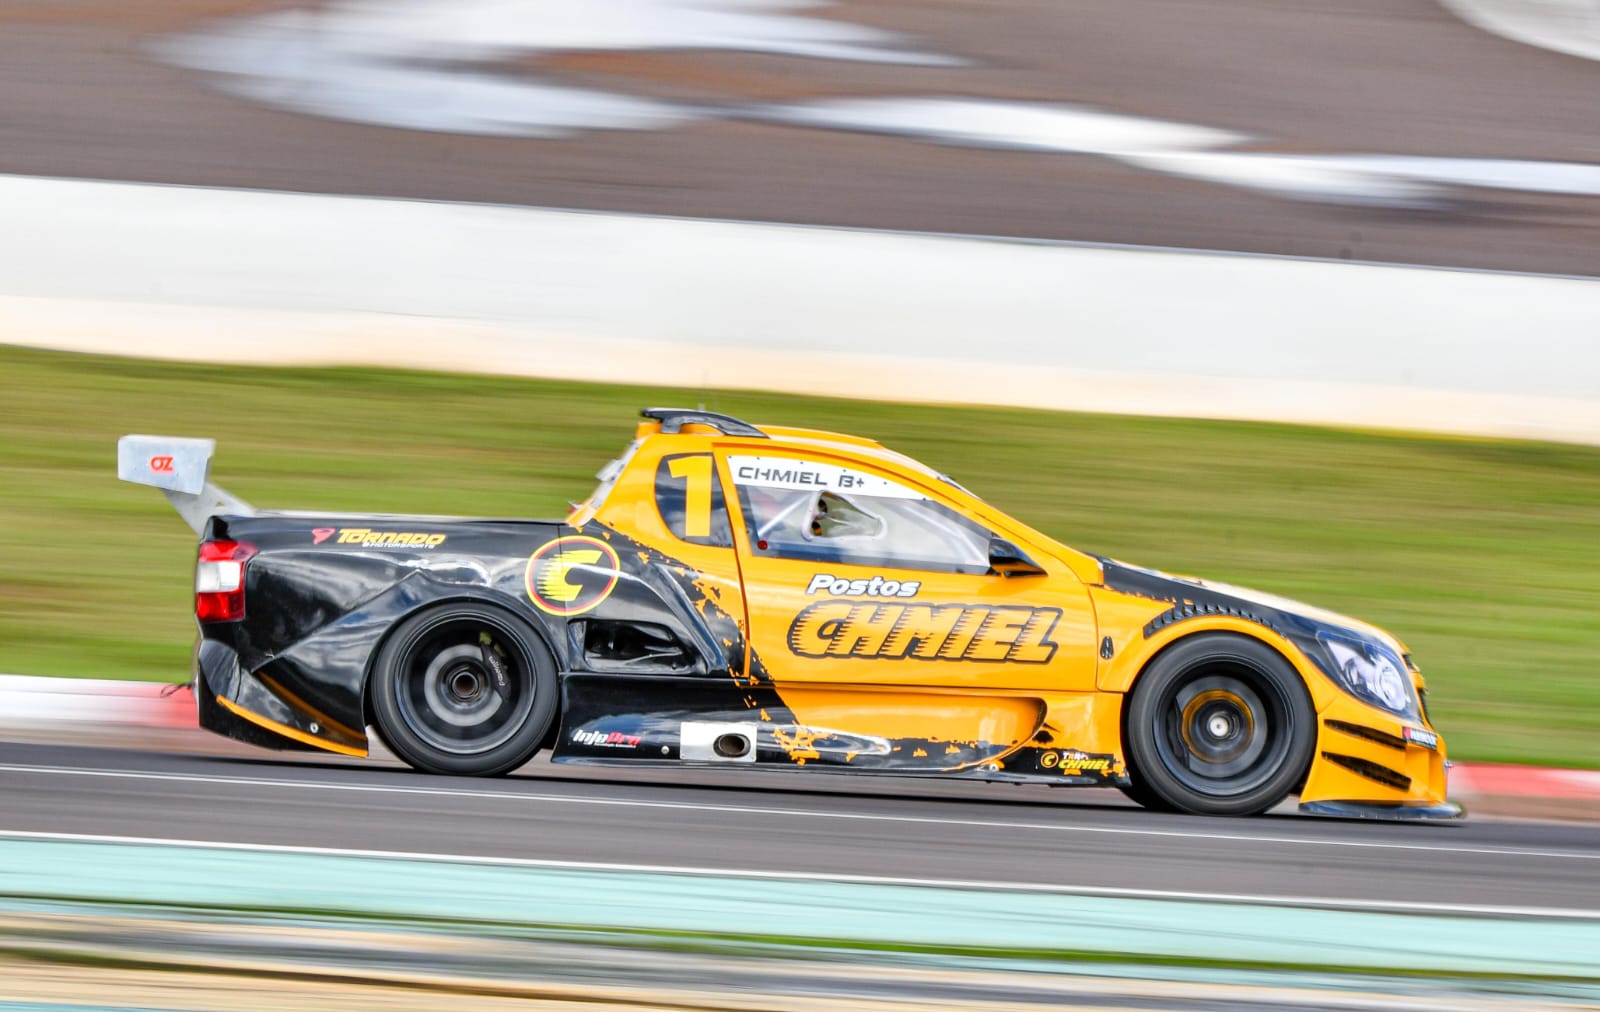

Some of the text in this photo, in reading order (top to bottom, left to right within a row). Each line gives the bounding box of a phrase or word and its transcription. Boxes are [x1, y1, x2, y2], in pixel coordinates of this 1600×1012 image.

[150, 456, 174, 472] OZ
[738, 466, 865, 488] CHMIEL B+
[667, 455, 713, 537] 1
[337, 528, 446, 545] TORNADO
[805, 574, 921, 597] Postos
[787, 600, 1063, 664] CHMIEL
[1058, 759, 1110, 769] CHMIEL
